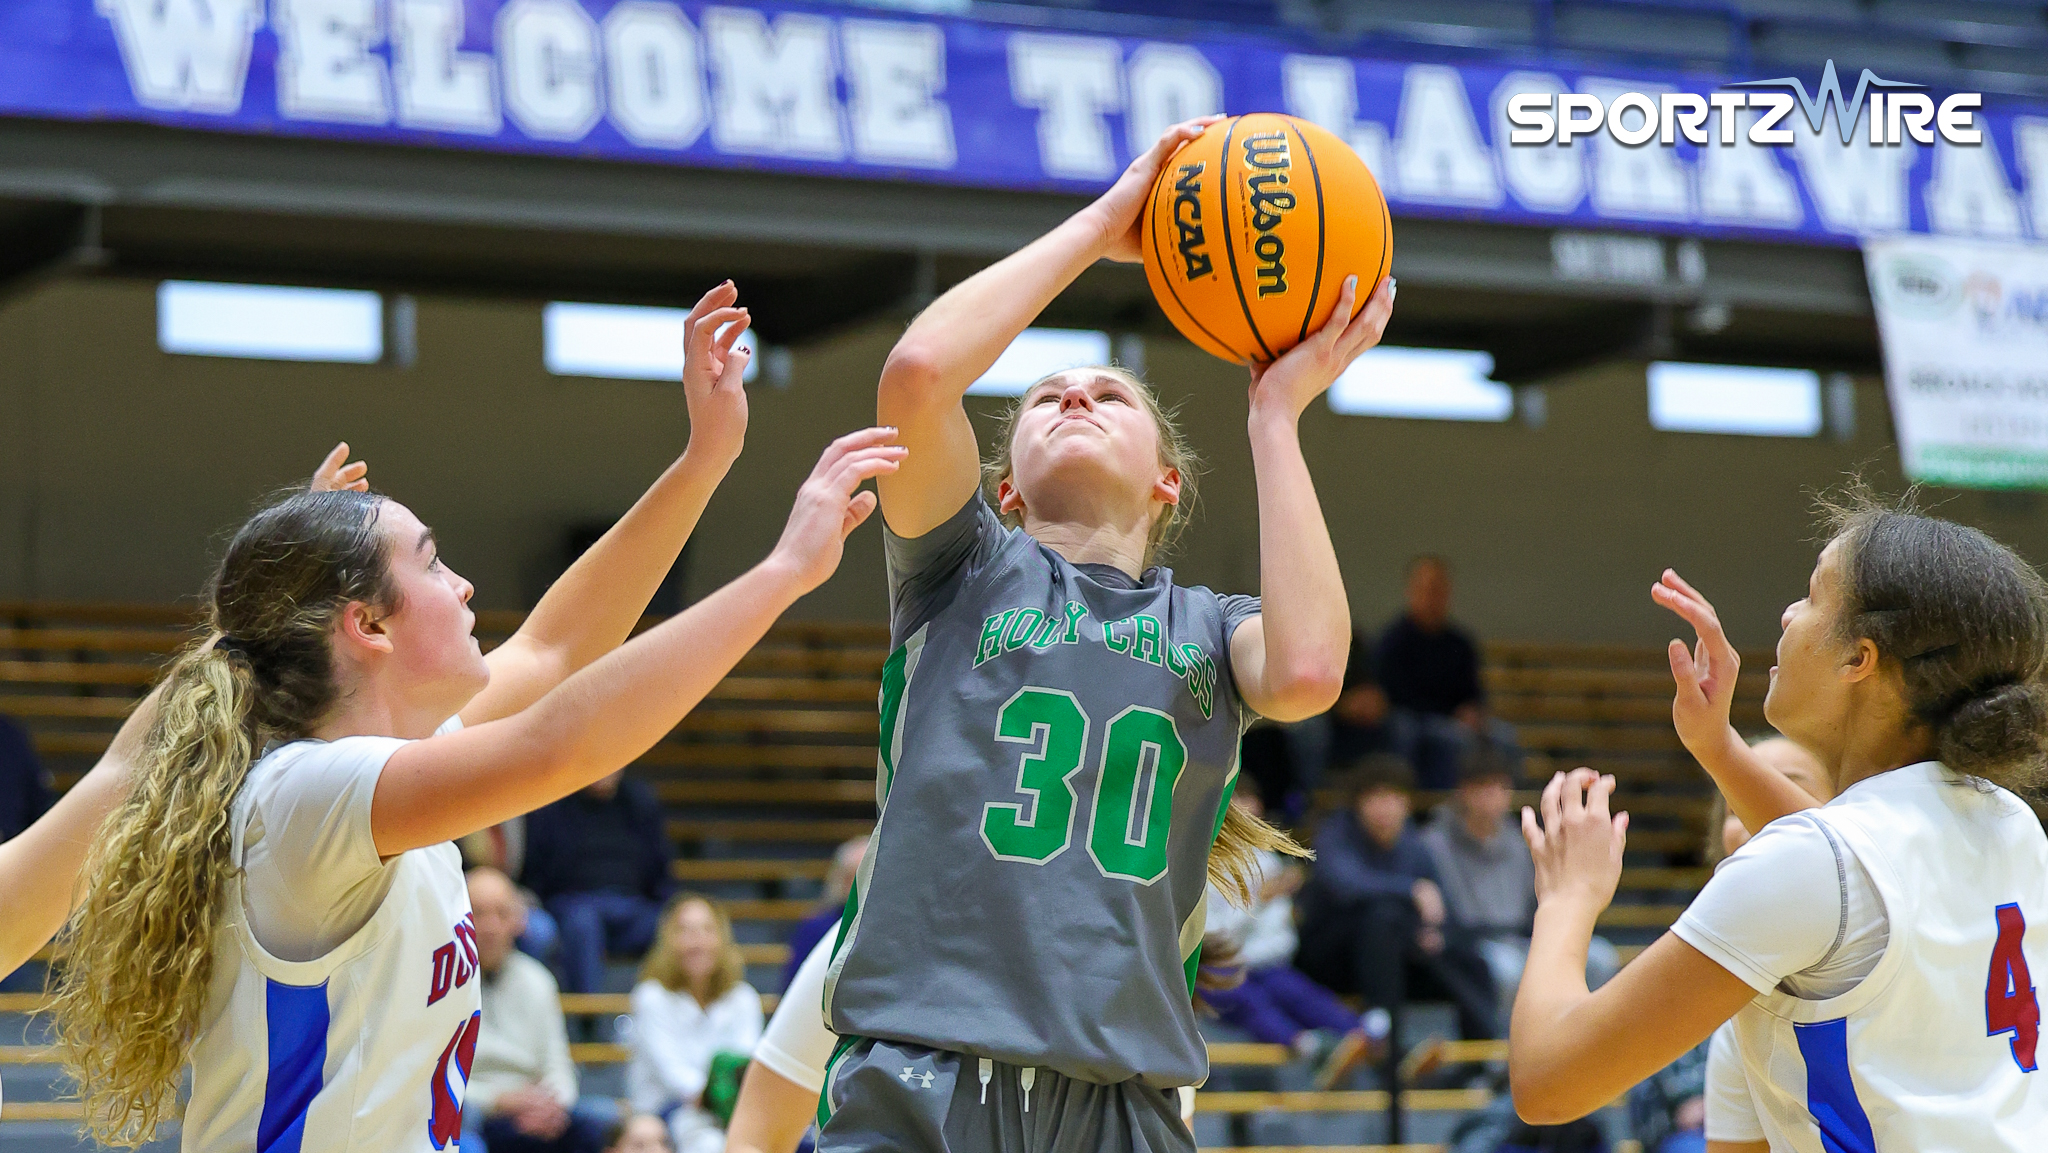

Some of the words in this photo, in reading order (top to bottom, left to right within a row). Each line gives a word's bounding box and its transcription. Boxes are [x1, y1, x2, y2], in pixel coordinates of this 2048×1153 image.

[92, 0, 959, 170] WELCOME
[1006, 32, 1227, 182] TO
[1173, 160, 1214, 282] NCAA
[1241, 130, 1297, 301] Wilson
[972, 600, 1090, 671] HOLY
[1101, 613, 1217, 721] CROSS
[979, 685, 1190, 887] 30
[1985, 902, 2041, 1074] 4
